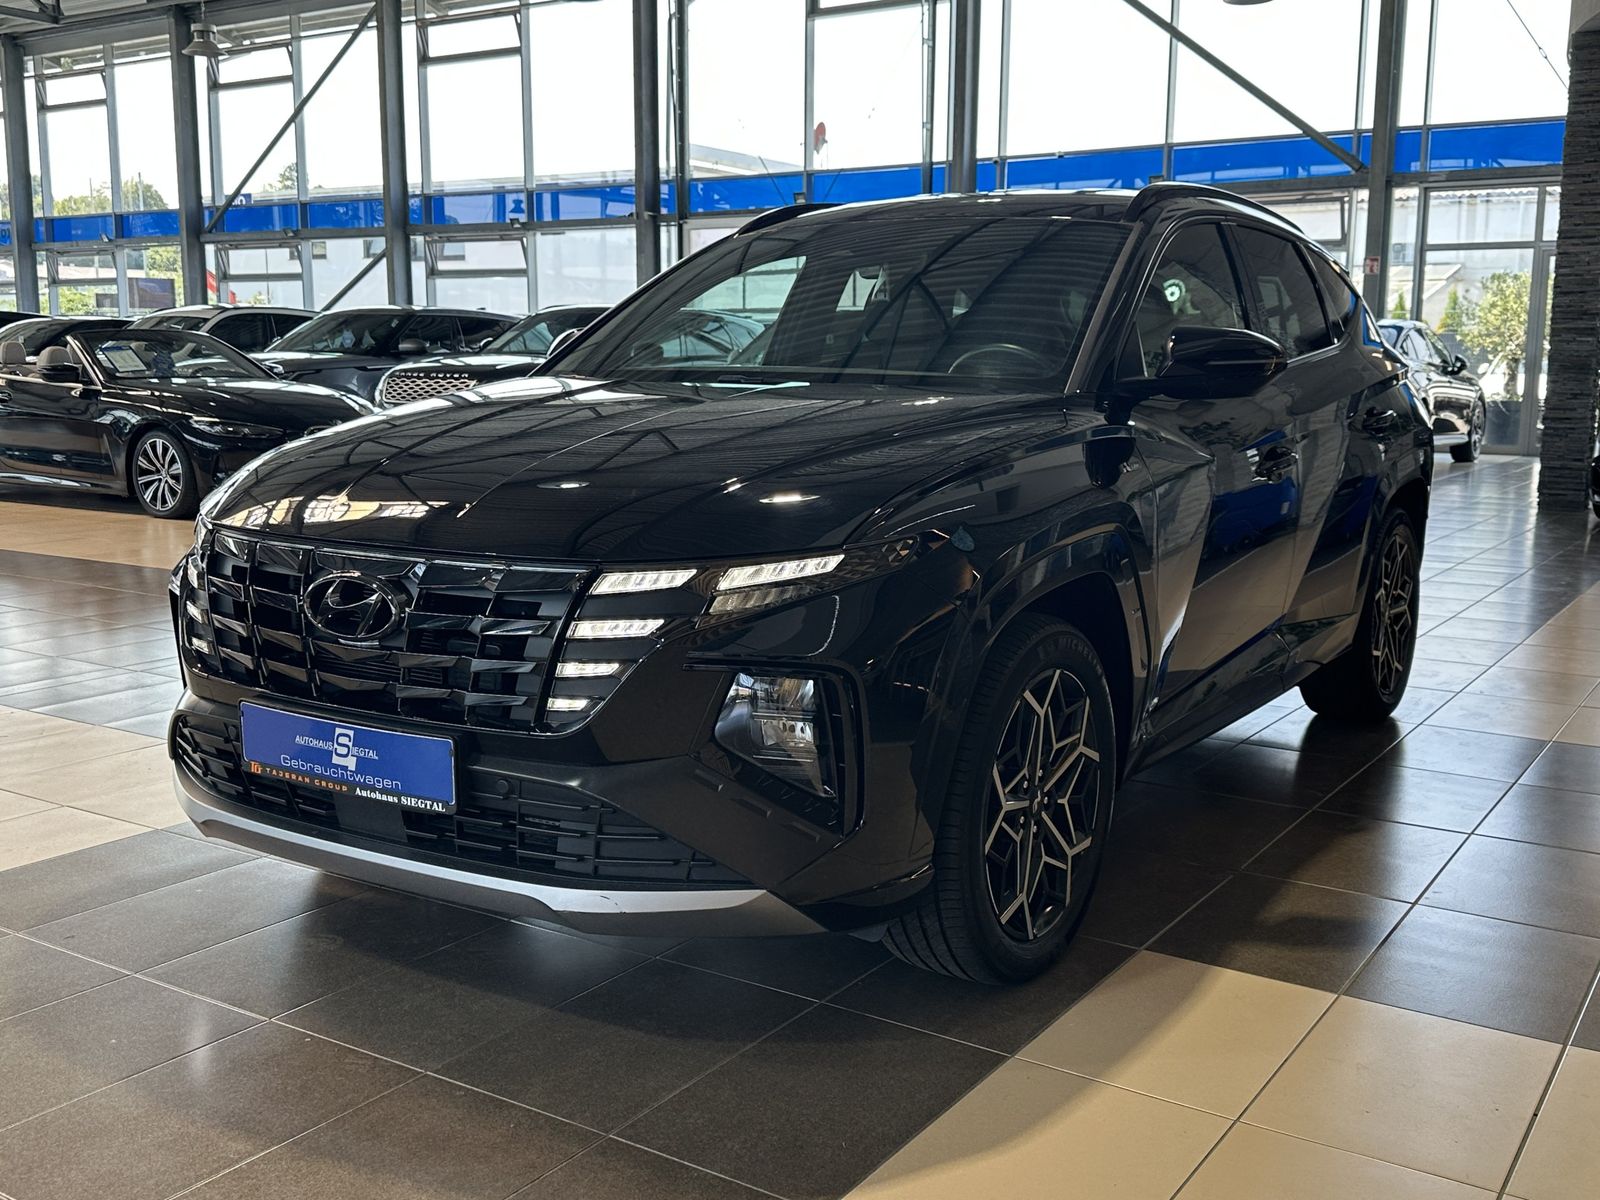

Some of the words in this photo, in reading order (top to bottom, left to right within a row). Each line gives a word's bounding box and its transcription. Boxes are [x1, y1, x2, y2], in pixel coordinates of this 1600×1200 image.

[295, 734, 334, 750] AUTOHAUS
[265, 767, 310, 784] TAJERAN
[314, 779, 348, 792] GROUP
[281, 754, 401, 790] Gebrauchtwagen
[355, 787, 398, 803] Autohaus
[401, 796, 445, 812] SIEGTAL
